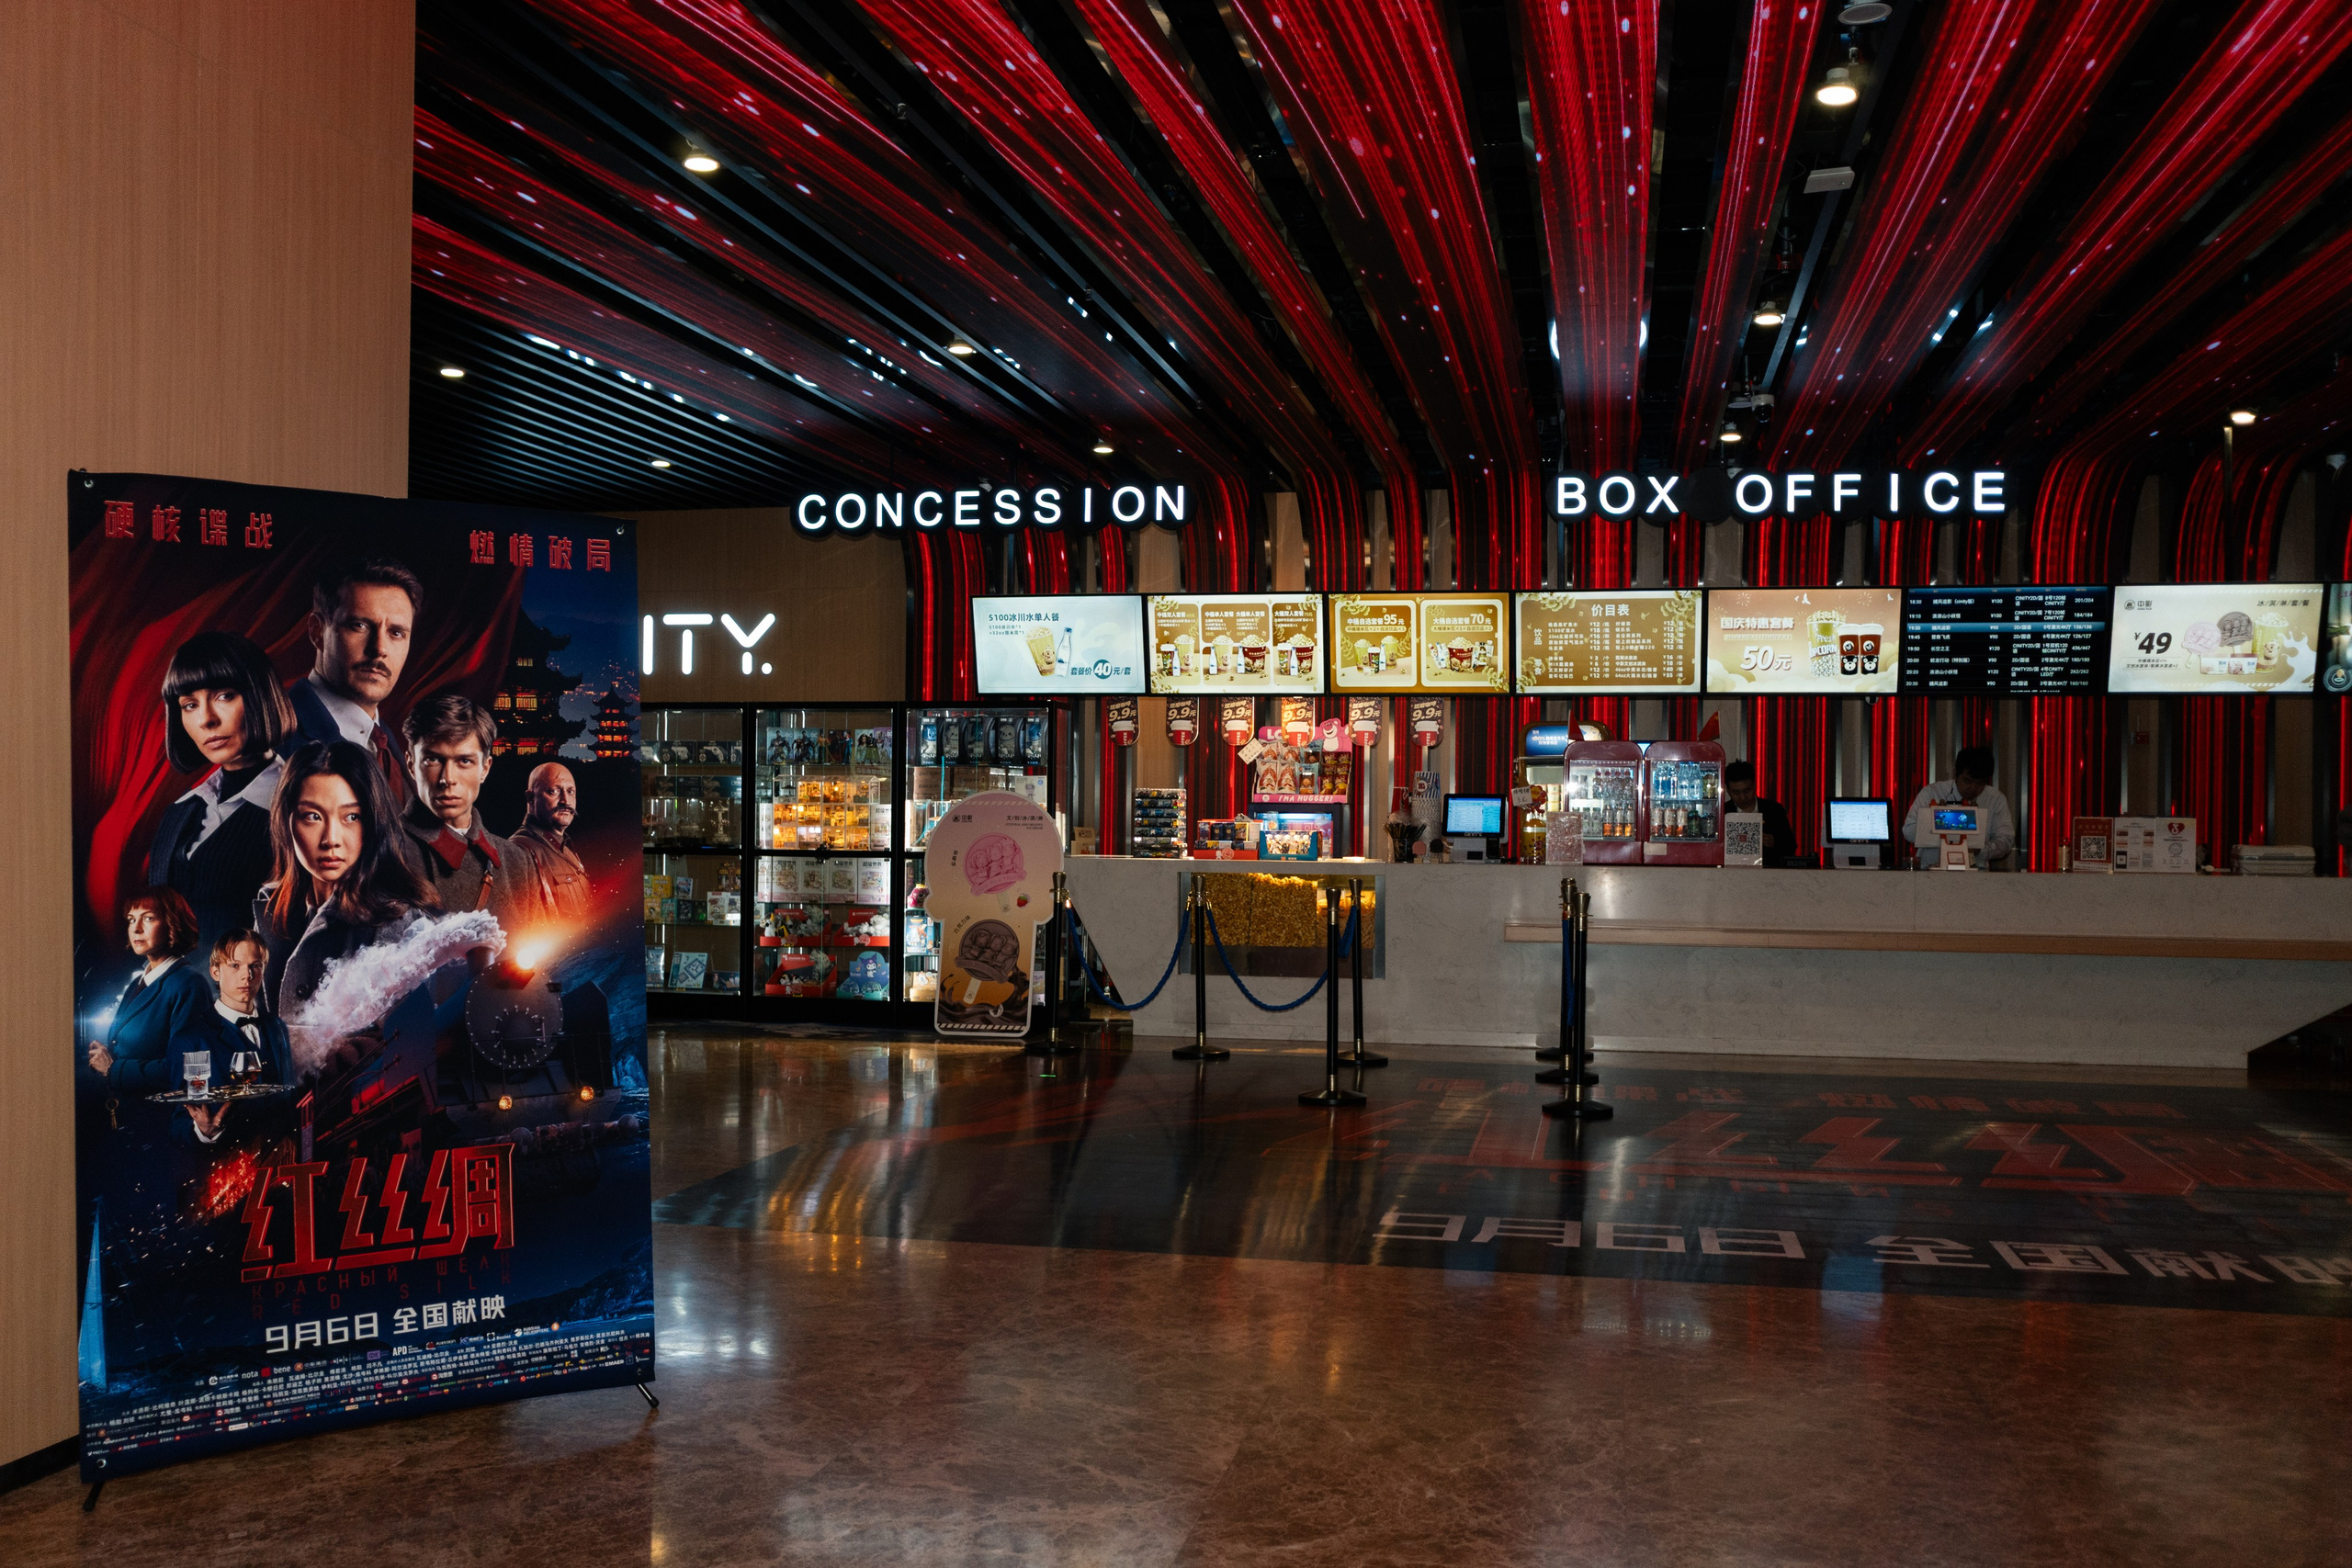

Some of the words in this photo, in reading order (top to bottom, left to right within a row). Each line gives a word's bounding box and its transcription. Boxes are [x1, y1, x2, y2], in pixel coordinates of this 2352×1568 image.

[1557, 476, 1679, 514] BOX
[1736, 472, 2006, 513] OFFICE
[798, 485, 1185, 530] CONCESSION
[104, 500, 273, 549] 硬核谍战
[469, 529, 611, 572] 燃情破局
[989, 613, 1059, 622] 5100冰川水单人餐
[1591, 604, 1630, 616] 价目表
[1721, 617, 1794, 630] 国庆特惠套餐
[2134, 632, 2172, 654] ¥49
[1740, 646, 1792, 671] 50元
[1109, 707, 1137, 722] 9.9元
[1167, 707, 1196, 720] 9.9元
[1222, 707, 1251, 720] 9.9元
[1283, 708, 1312, 721] 9.9元
[1351, 707, 1380, 721] 9.9元
[1411, 707, 1442, 721] 9.9元
[241, 1143, 515, 1283] 红丝绸
[266, 1311, 379, 1354] 9月6日
[392, 1294, 506, 1335] 全国献映
[392, 1345, 407, 1356] APD
[242, 1370, 258, 1379] nota
[273, 1364, 290, 1374] bene
